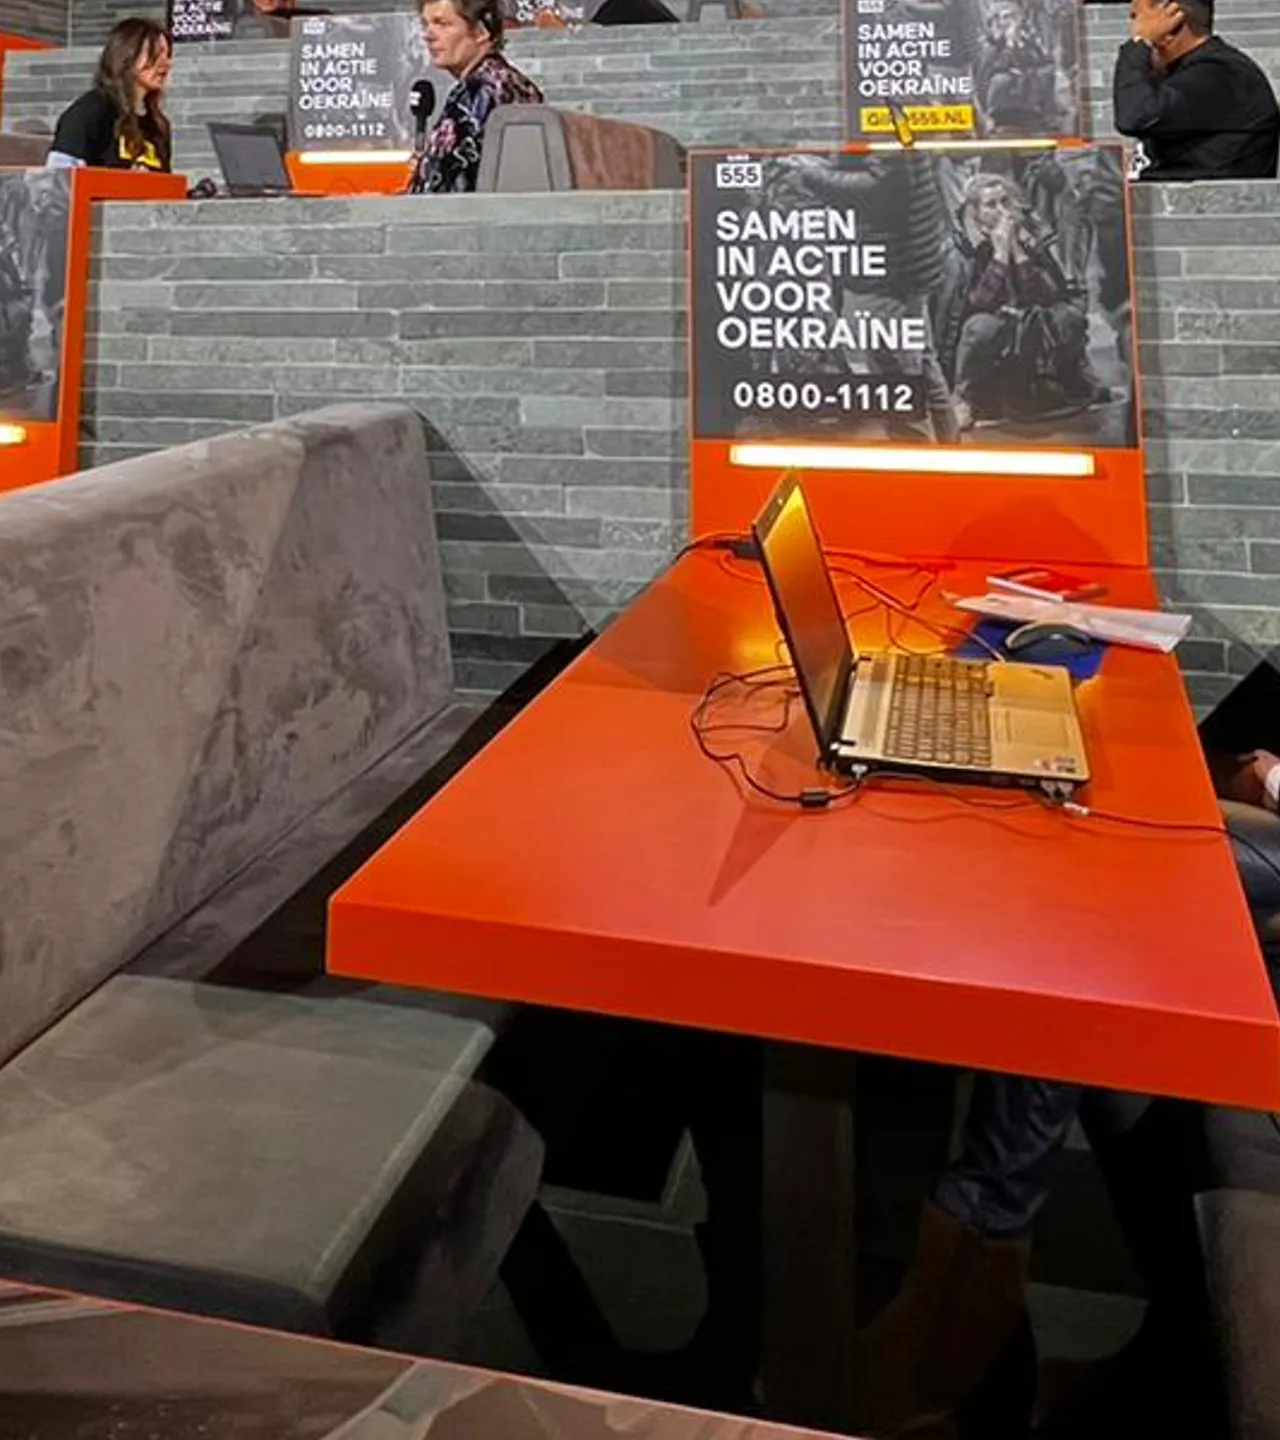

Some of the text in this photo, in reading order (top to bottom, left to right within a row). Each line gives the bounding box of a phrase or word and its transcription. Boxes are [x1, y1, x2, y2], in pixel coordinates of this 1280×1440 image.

[857, 22, 934, 41] SAMEN
[301, 42, 365, 60] SAMEN
[858, 40, 951, 59] IN ACTIE
[300, 58, 377, 76] IN ACTIE
[858, 60, 922, 78] VOOR
[300, 77, 353, 92] VOOR
[720, 165, 759, 184] 555
[716, 209, 856, 241] SAMEN
[717, 245, 886, 276] IN ACTIE
[716, 281, 832, 312] VOOR
[717, 310, 926, 350] OEKRAÏNE
[734, 381, 914, 410] 0800-1112
